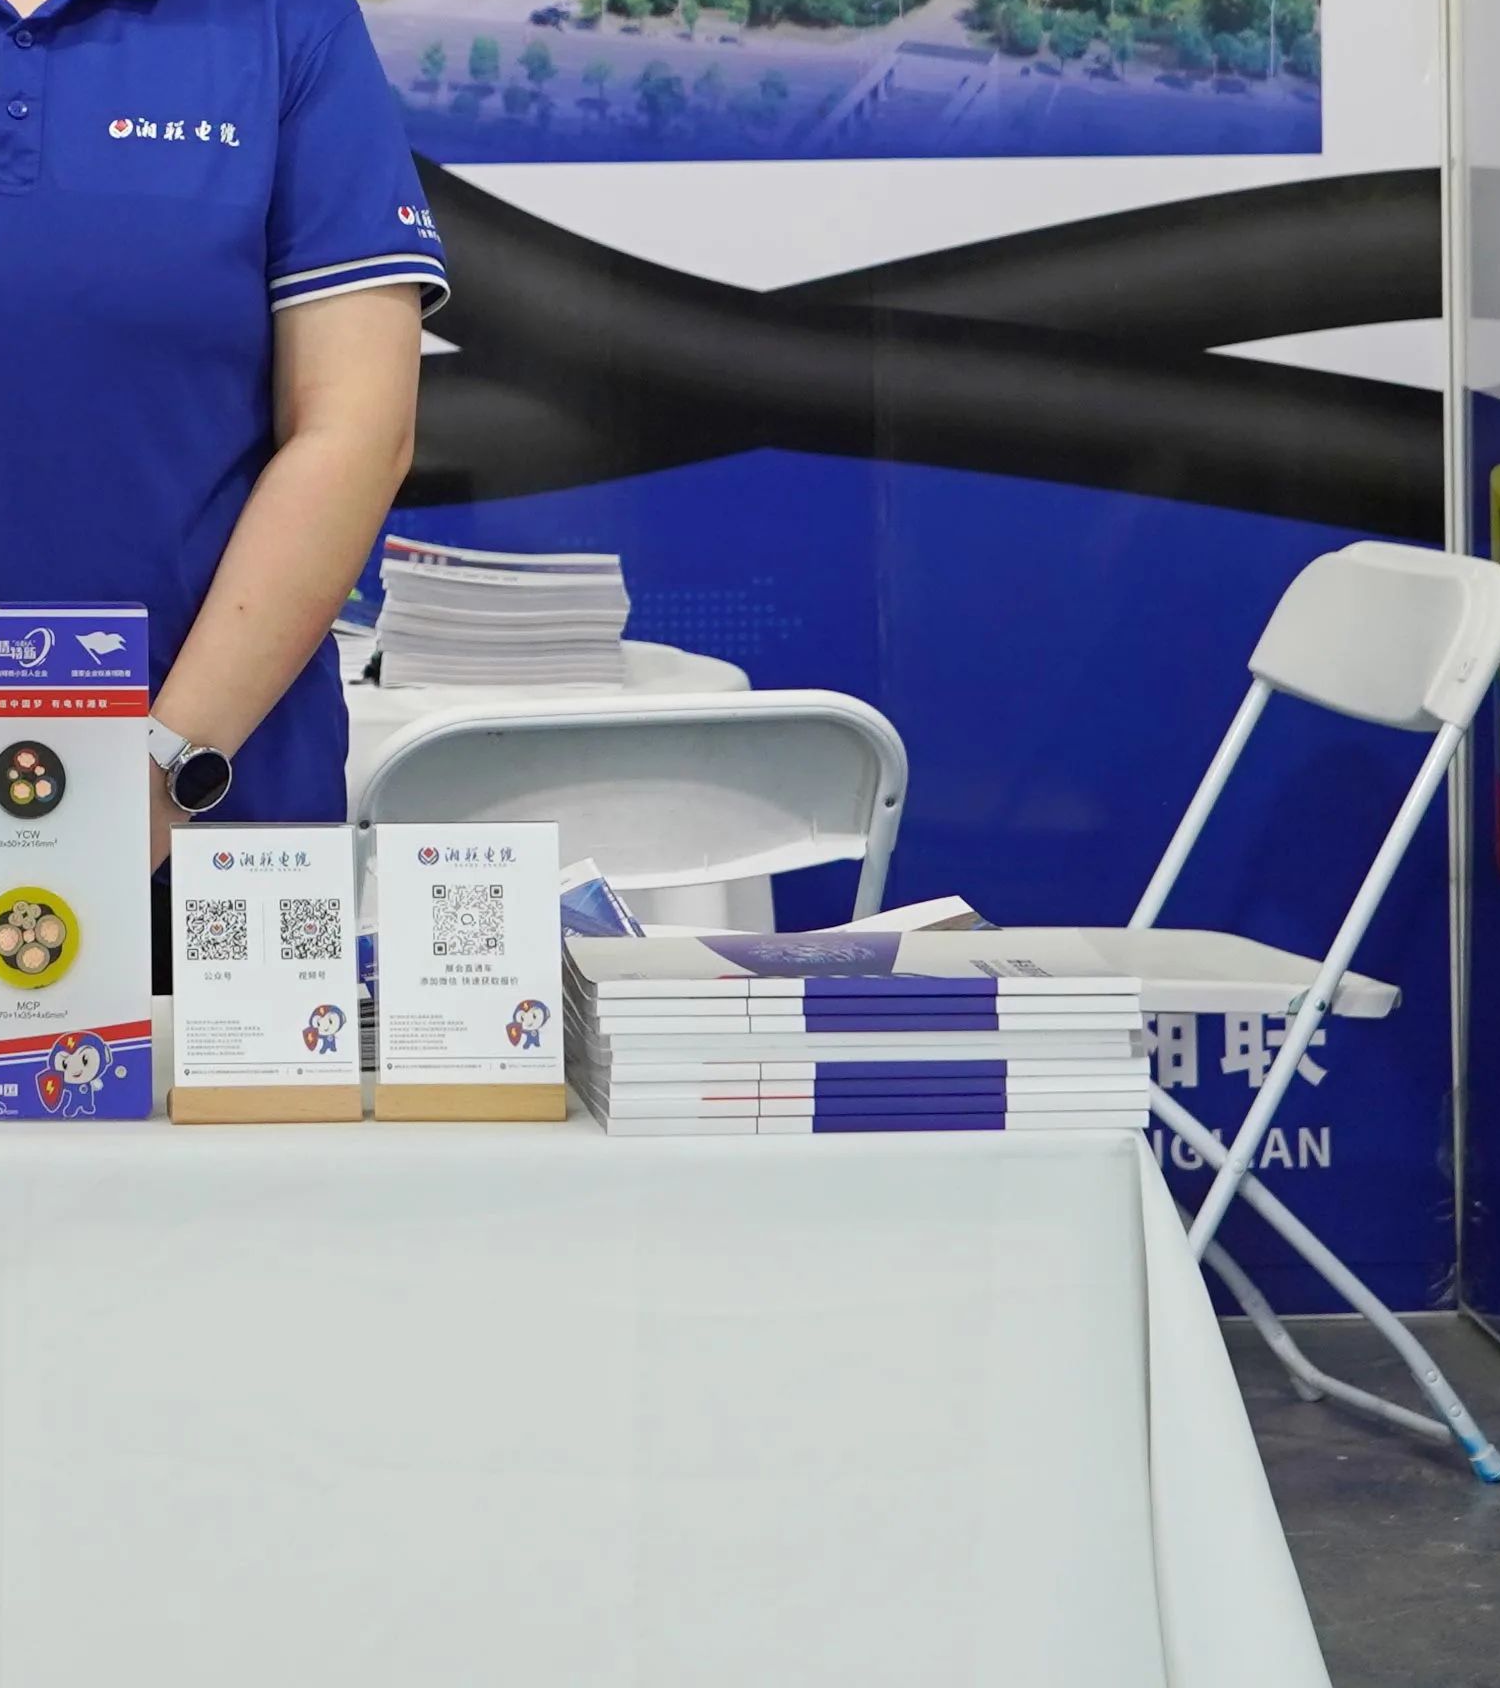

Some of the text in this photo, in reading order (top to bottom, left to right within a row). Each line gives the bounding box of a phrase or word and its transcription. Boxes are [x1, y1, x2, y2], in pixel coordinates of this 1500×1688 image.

[135, 117, 240, 146] 湘联电缆
[16, 831, 40, 839] YCW
[240, 850, 311, 868] 湘联电缆
[444, 846, 516, 863] 湘联电缆
[445, 964, 492, 973] 展会直通车
[204, 971, 232, 980] 公众号
[298, 971, 326, 980] 视频号
[420, 976, 519, 985] 添加微信 快速获取报价
[17, 1001, 40, 1010] MCP
